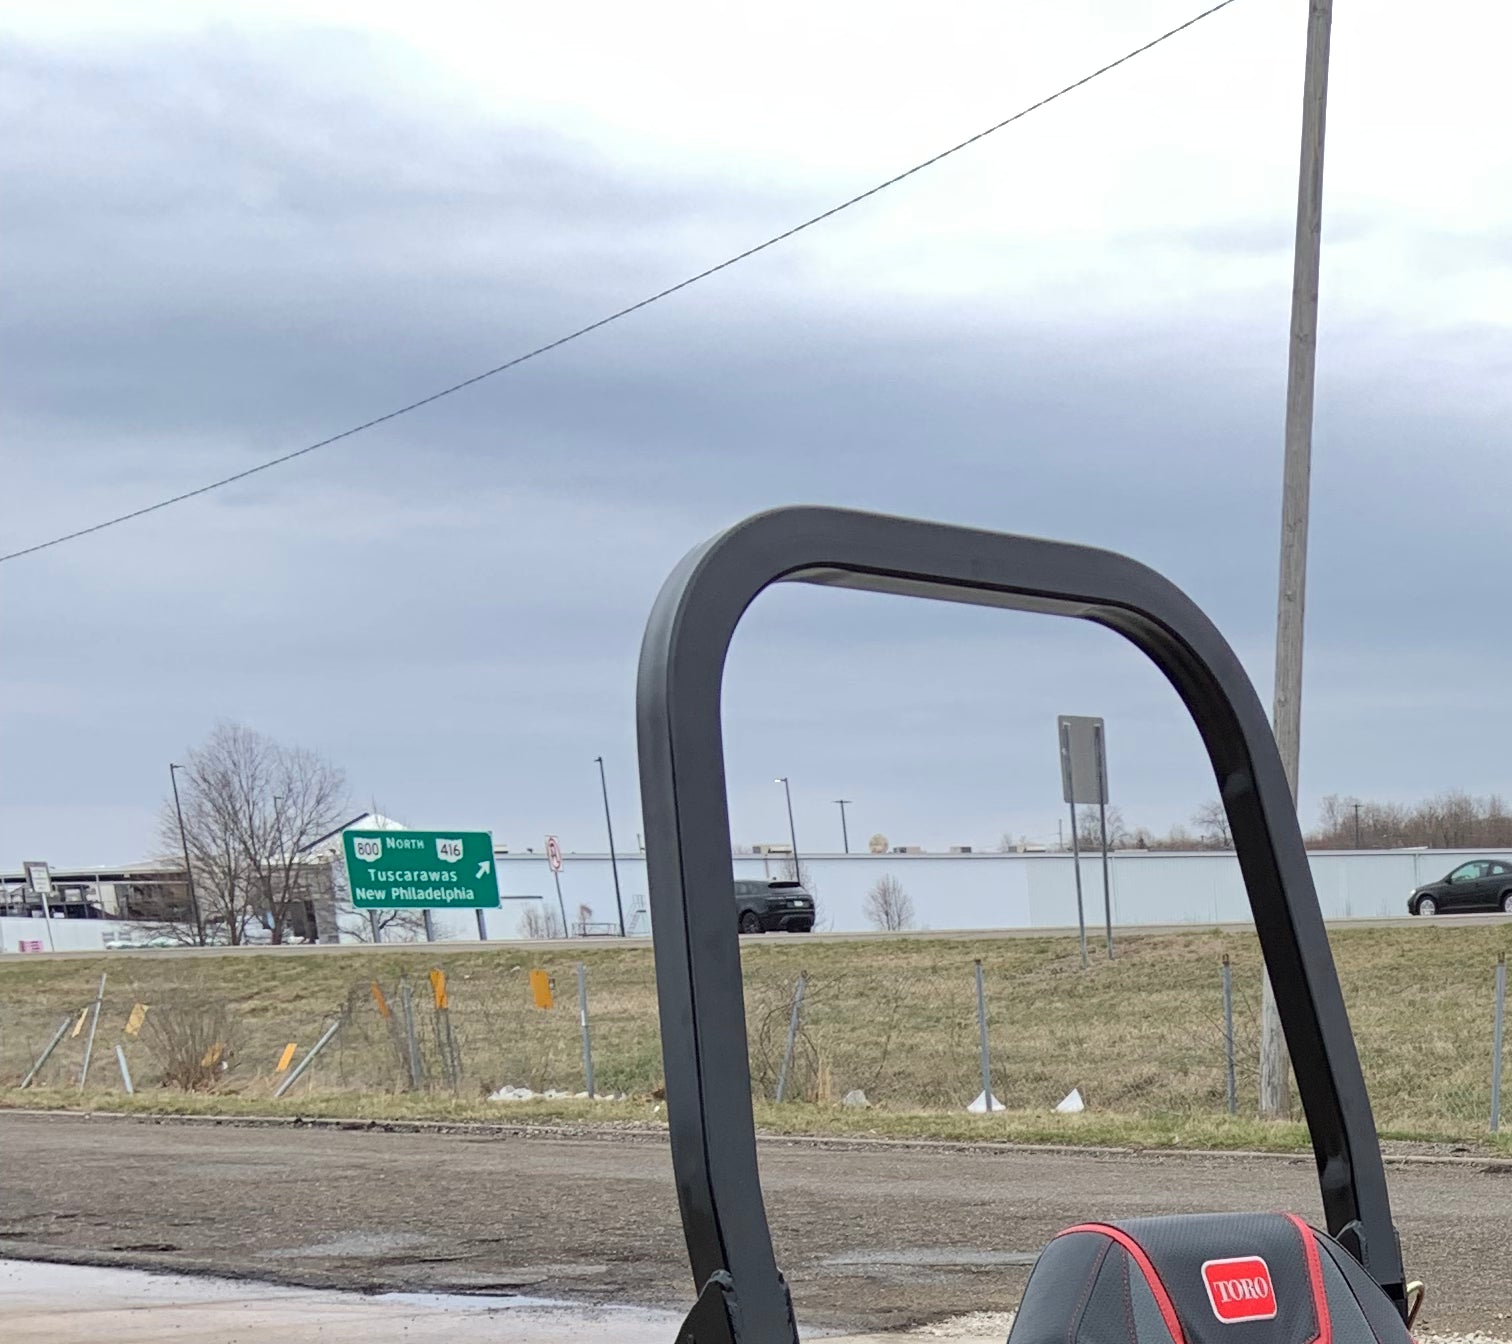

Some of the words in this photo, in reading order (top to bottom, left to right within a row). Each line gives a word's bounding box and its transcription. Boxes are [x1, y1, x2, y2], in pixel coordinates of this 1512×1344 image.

[357, 842, 379, 856] 800
[440, 843, 461, 857] 416
[368, 868, 458, 882] Tuscarawas
[355, 887, 386, 900] New
[391, 887, 475, 903] Philadelphia
[1212, 1276, 1269, 1304] TORO
